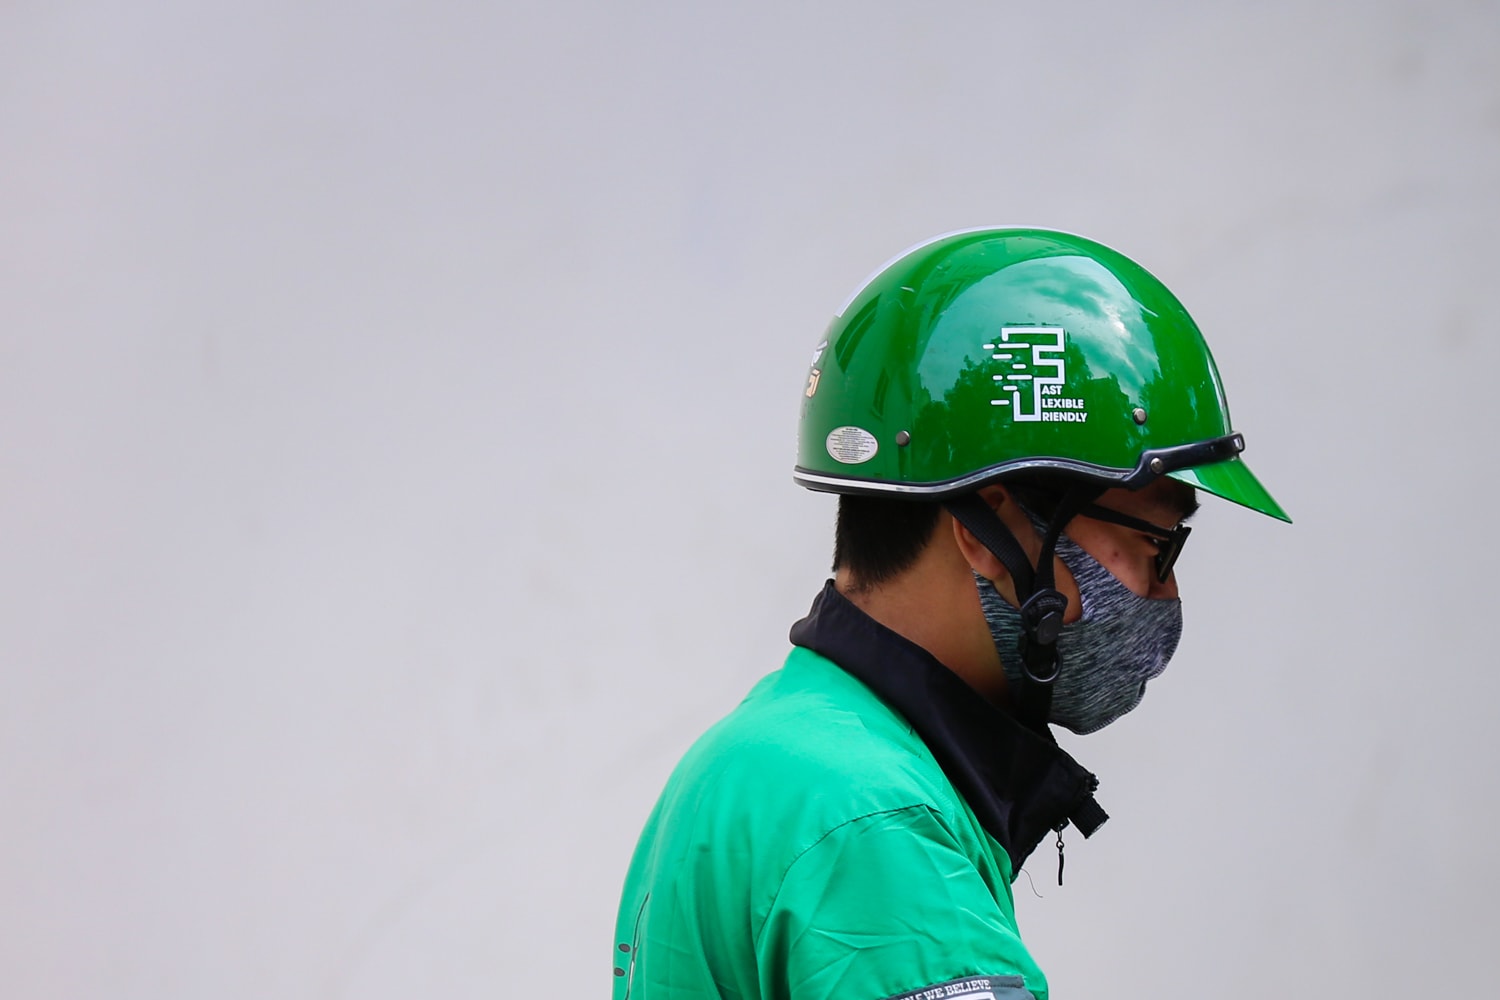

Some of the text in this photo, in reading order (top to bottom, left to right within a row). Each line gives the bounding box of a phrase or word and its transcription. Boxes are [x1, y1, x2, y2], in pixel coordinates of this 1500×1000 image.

[1041, 385, 1062, 395] AST
[1041, 398, 1084, 409] LEXIBLE
[1042, 411, 1087, 422] RIENDLY
[923, 987, 945, 1000] WE
[944, 979, 992, 996] BELIEVE
